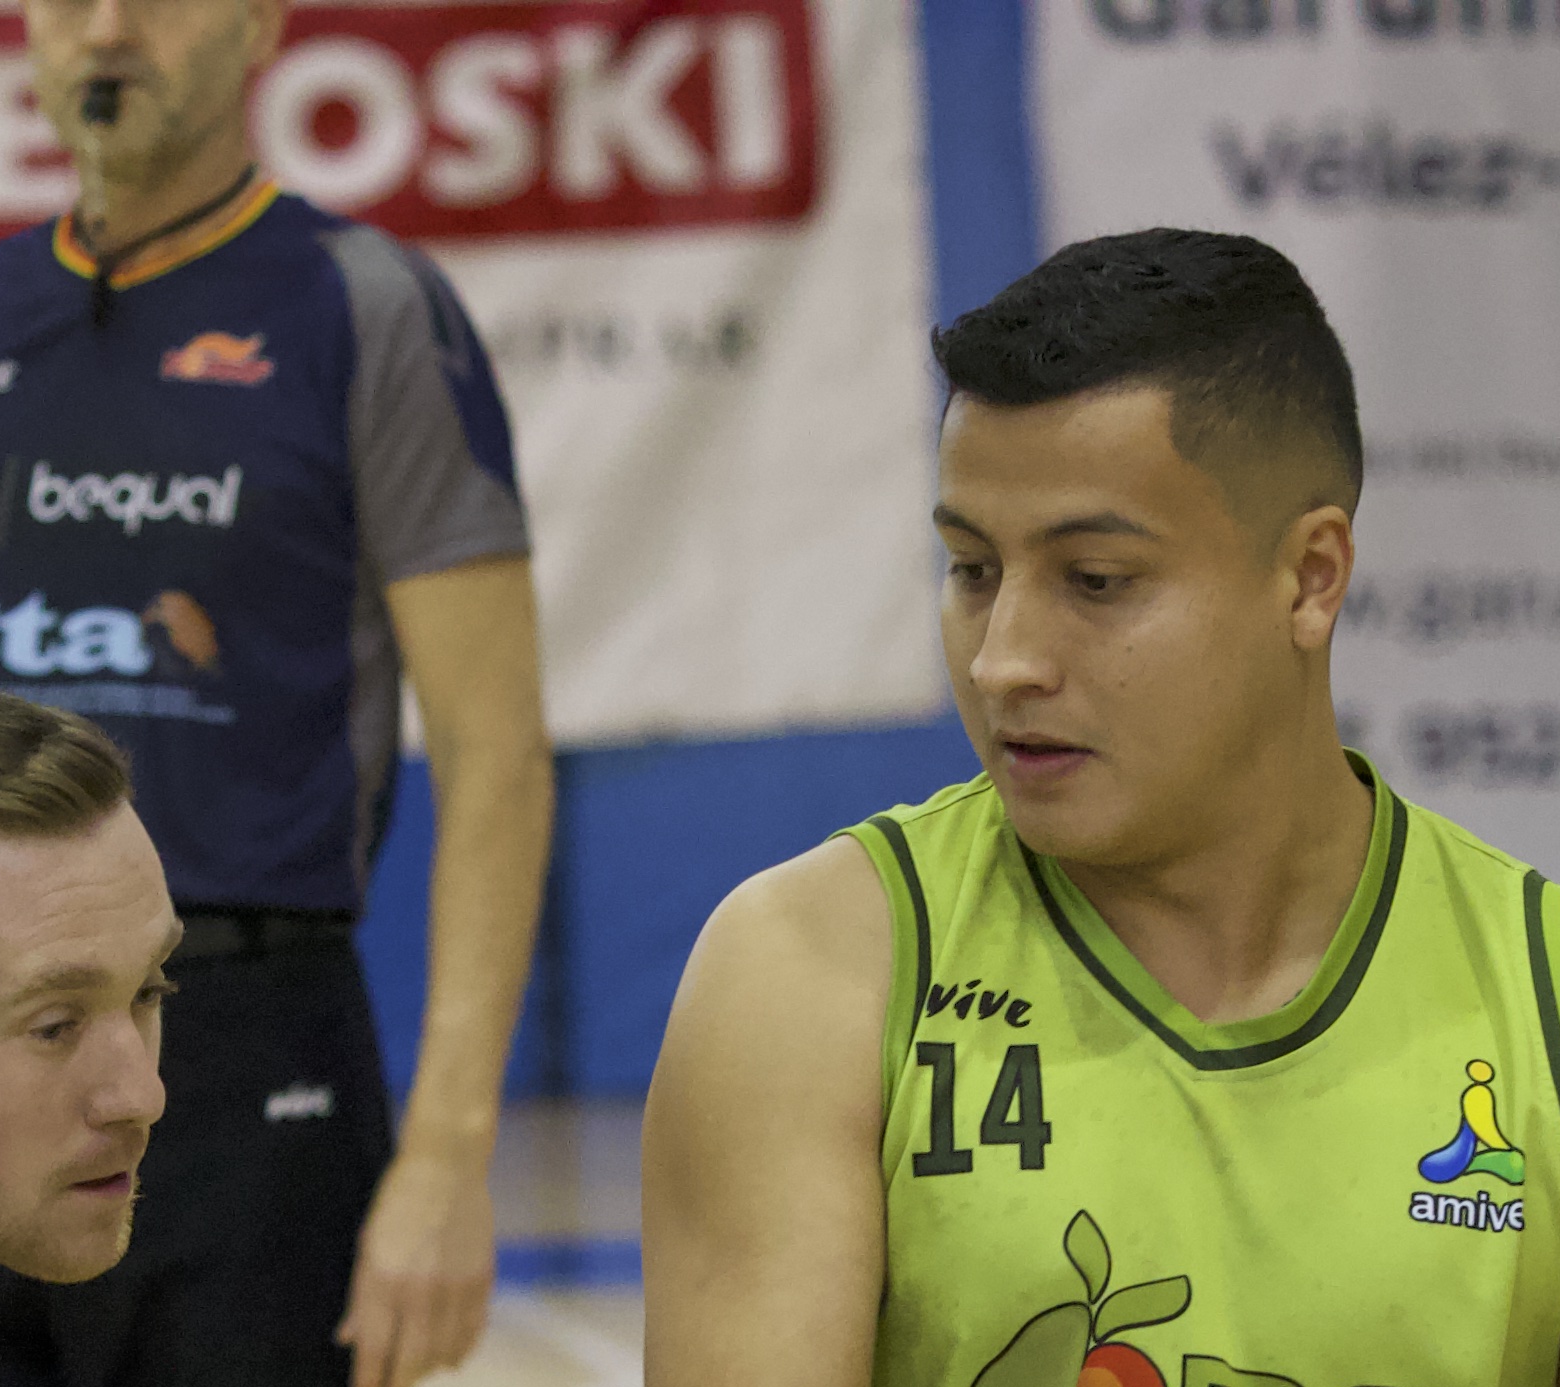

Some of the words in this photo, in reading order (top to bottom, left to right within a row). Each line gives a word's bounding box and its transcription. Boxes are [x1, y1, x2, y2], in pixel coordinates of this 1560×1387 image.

[26, 459, 244, 537] bequal
[924, 978, 1033, 1028] vive
[911, 1041, 1052, 1178] 14
